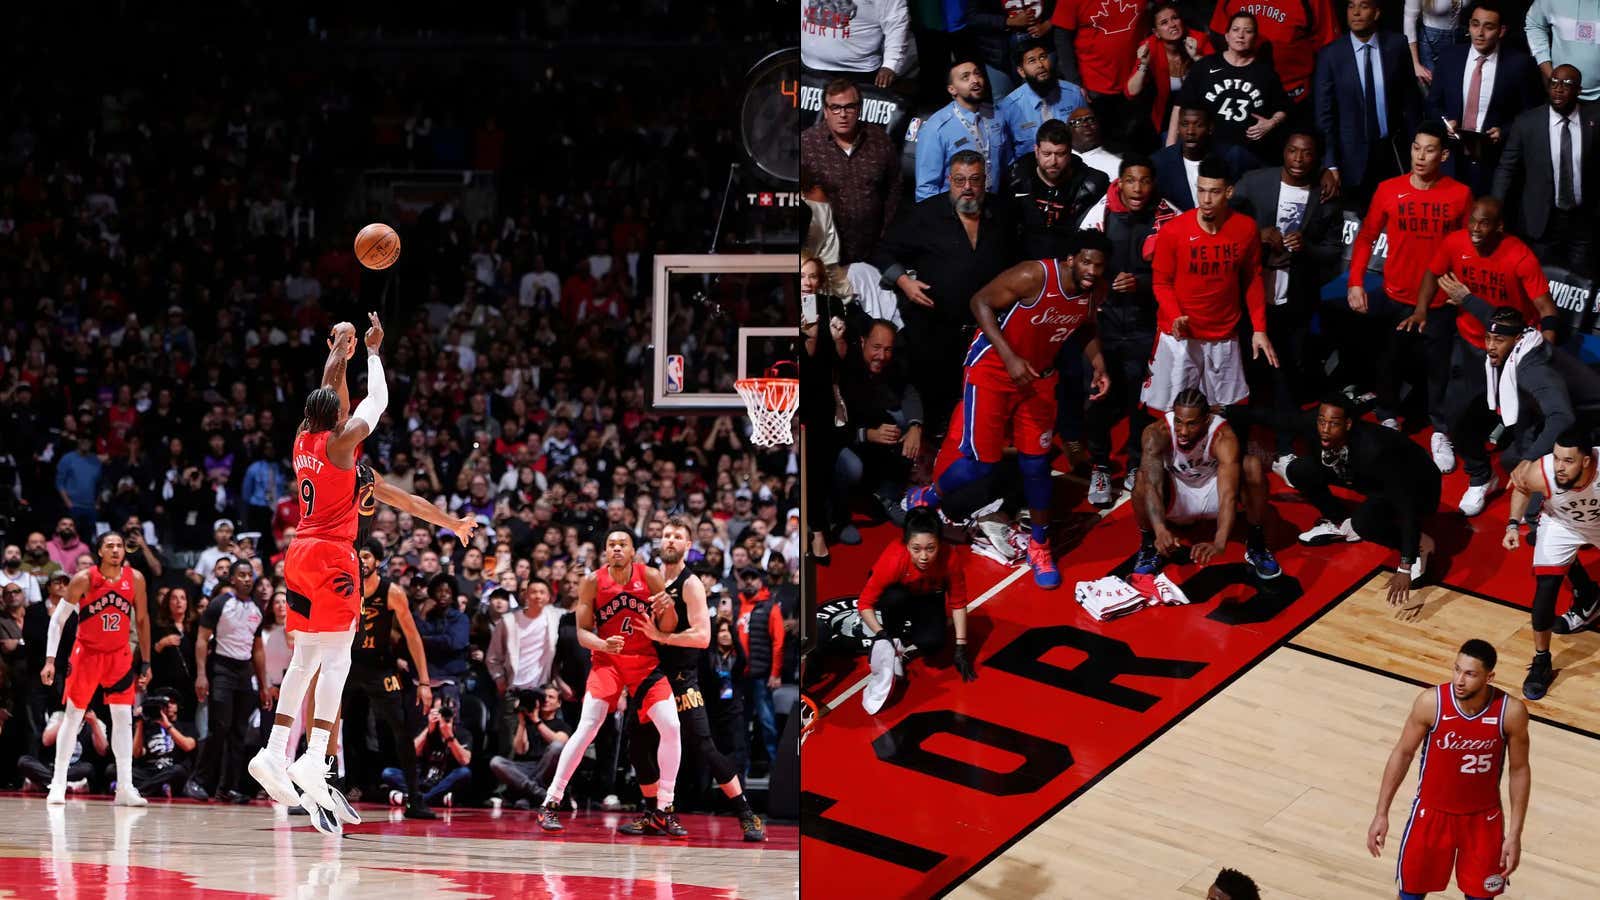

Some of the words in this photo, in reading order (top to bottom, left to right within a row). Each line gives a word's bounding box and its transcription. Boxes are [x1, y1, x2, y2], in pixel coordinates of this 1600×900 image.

[780, 79, 798, 109] 4
[1204, 78, 1263, 109] RAPTORS
[1216, 97, 1250, 122] 43
[1422, 202, 1450, 218] THE
[1397, 217, 1450, 234] NORTH
[1213, 242, 1240, 259] THE
[1481, 269, 1506, 287] THE
[300, 478, 316, 519] 9
[1571, 508, 1600, 523] 23
[101, 612, 121, 632] 12
[621, 616, 634, 635] 4
[1436, 731, 1498, 751] Sixers
[1460, 753, 1494, 774] 25
